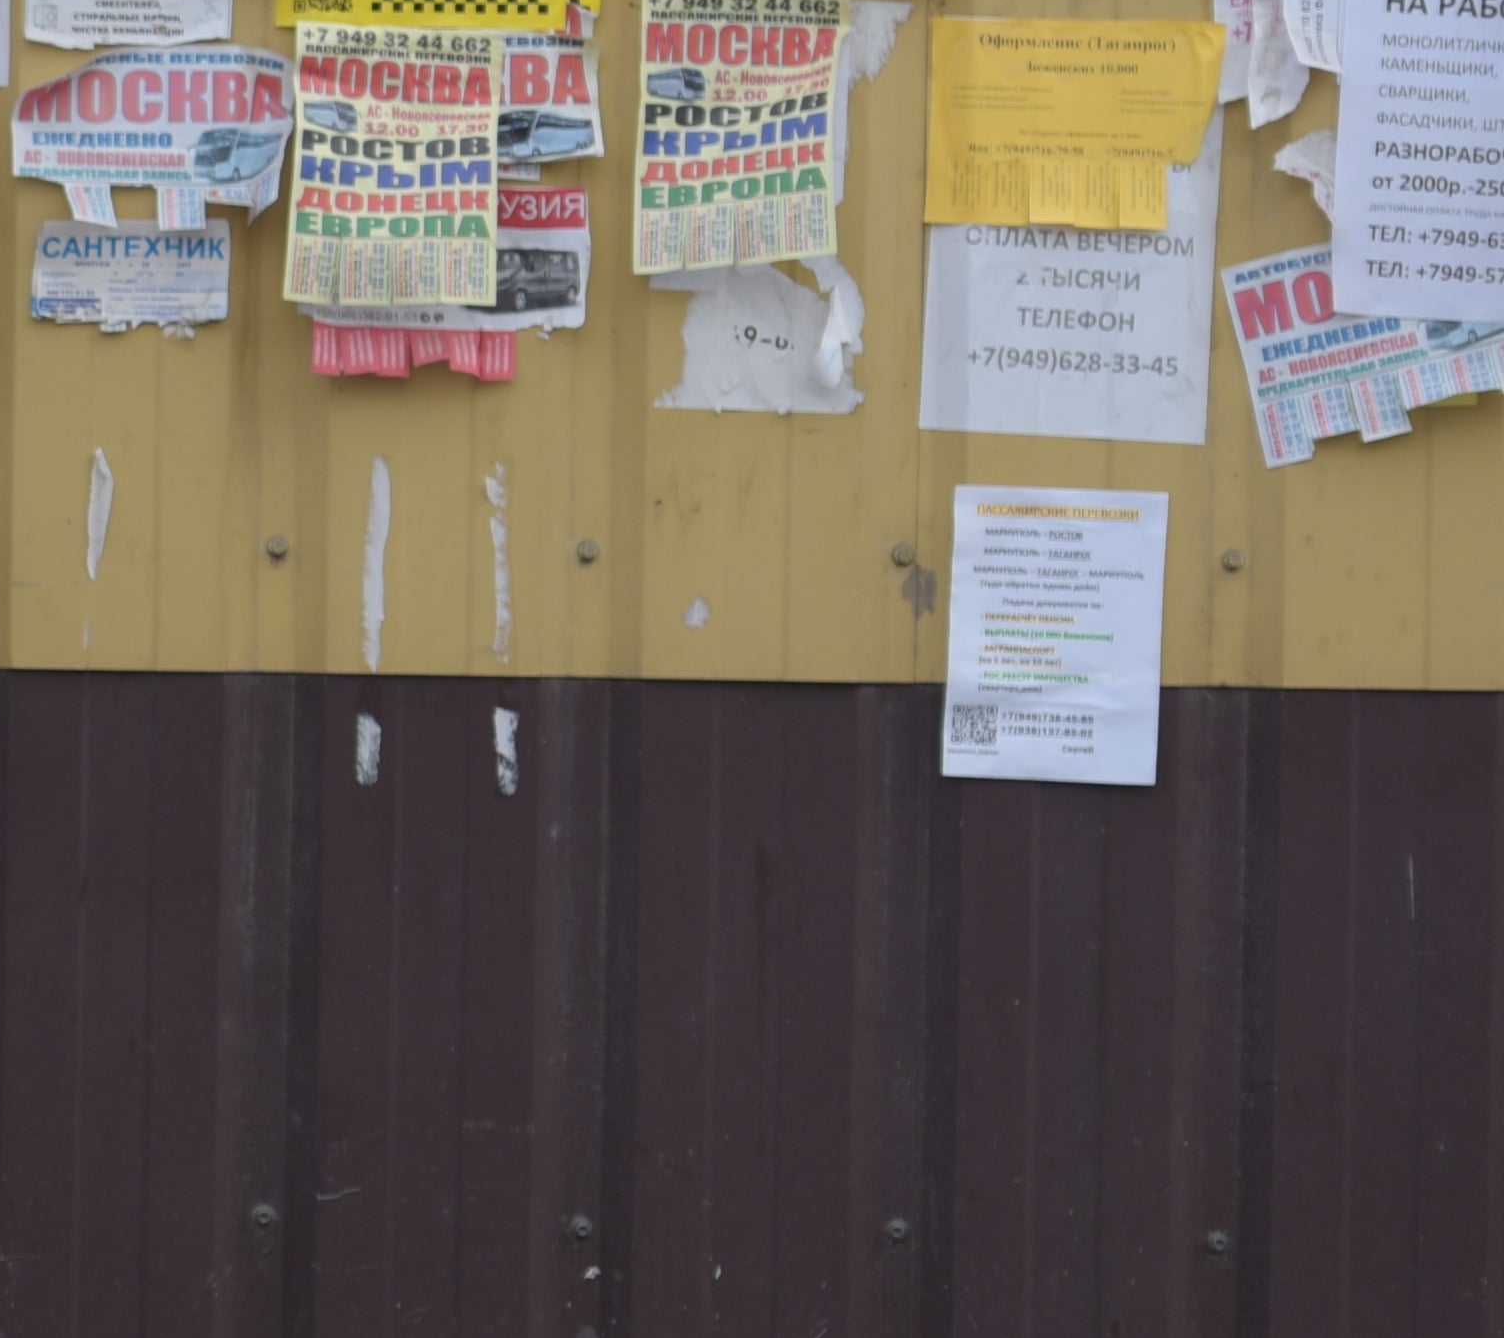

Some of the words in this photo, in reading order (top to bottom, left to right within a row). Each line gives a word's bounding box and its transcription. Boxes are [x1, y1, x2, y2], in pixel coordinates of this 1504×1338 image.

[303, 27, 329, 45] +7
[336, 28, 378, 46] 949
[384, 31, 410, 49] 32
[417, 33, 443, 51] 44
[450, 36, 492, 54] 662
[646, 22, 838, 68] МОСКВА
[19, 69, 283, 124] МОСКВА
[300, 55, 489, 107] МОСКВА
[644, 93, 827, 127] РОСТОВ
[32, 131, 174, 150] ЕЖЕДНЕВНО
[301, 132, 489, 159] РОСТОВ
[642, 115, 827, 155] КРЫМ
[300, 159, 488, 189] КРЫМ
[641, 142, 826, 184] ДОНЕЦК
[295, 187, 488, 213] ДОНЕЦК
[641, 167, 827, 209] ЕВРОПА
[295, 212, 489, 237] ЕВРОПА
[41, 233, 227, 261] САНТЕХНИК
[1076, 232, 1194, 258] ВЕЧЕРОМ
[1016, 306, 1136, 333] ТЕЛЕФОН
[1261, 315, 1401, 361] ЕЖЕДНЕВНО
[967, 346, 1179, 378] +7(949)628-33-45
